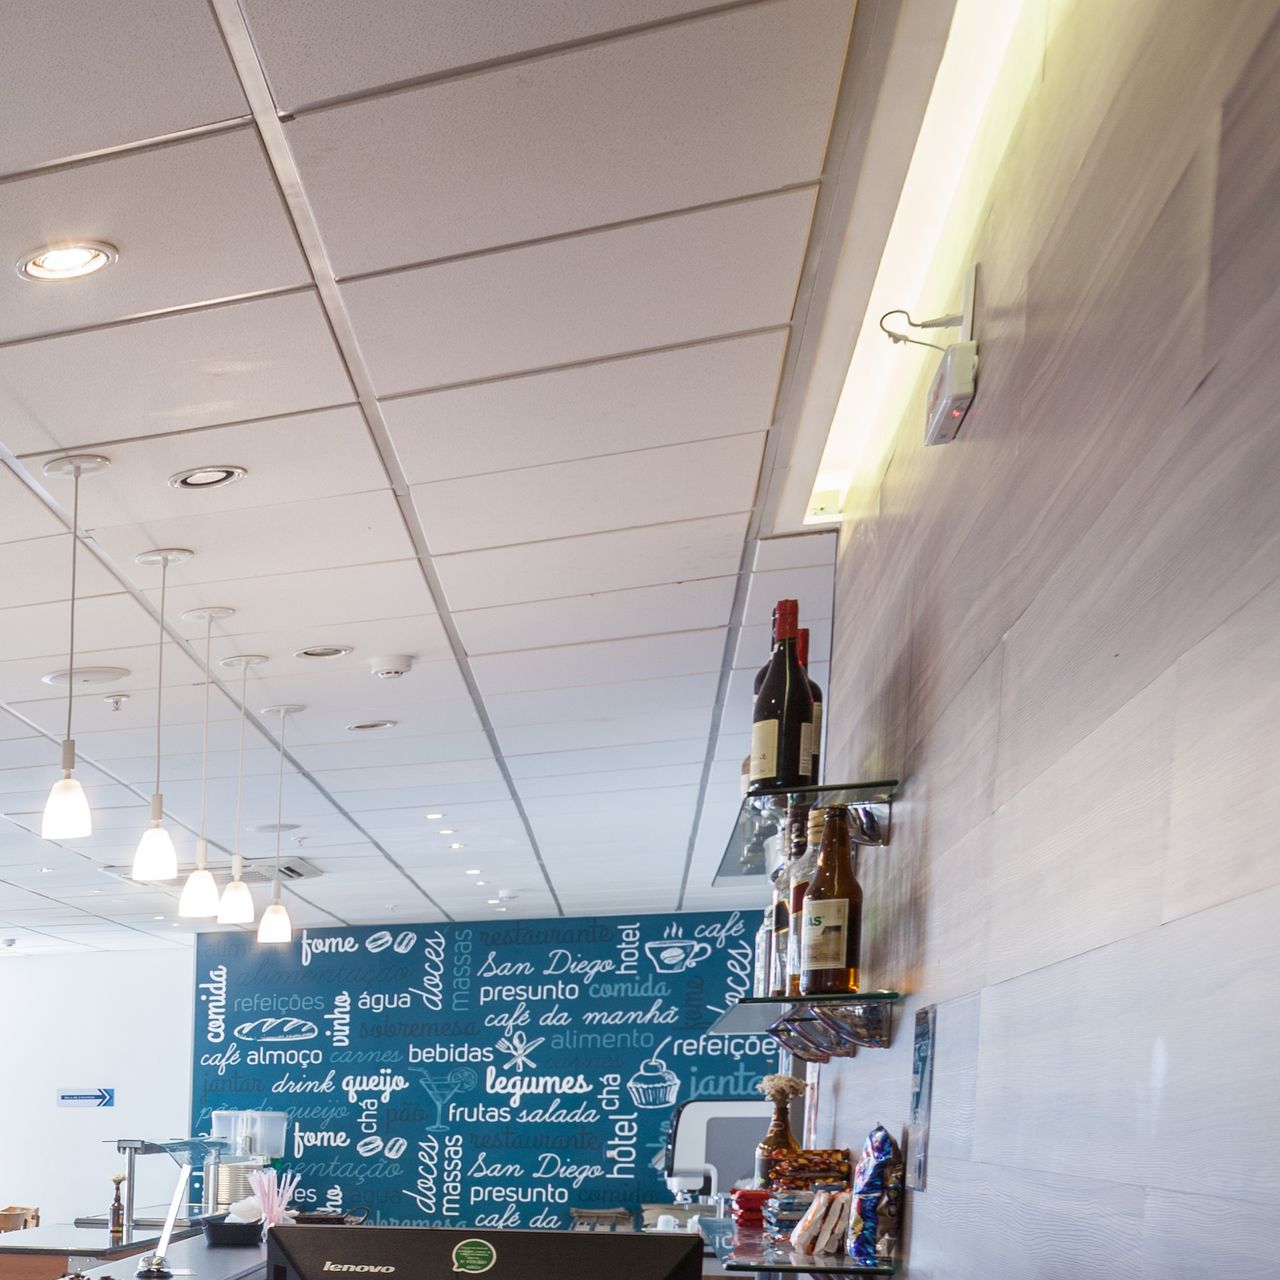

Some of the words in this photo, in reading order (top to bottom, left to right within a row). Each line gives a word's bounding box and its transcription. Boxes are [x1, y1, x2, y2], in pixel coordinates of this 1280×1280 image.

[479, 917, 614, 946] restaurante
[694, 911, 745, 948] café
[301, 929, 359, 966] fome
[615, 922, 641, 975] hotel
[408, 930, 446, 1011] doces
[452, 928, 473, 1012] massas
[477, 951, 535, 977] San
[542, 950, 615, 984] Diego
[358, 992, 412, 1012] água
[480, 980, 579, 1005] presunto
[589, 974, 671, 998] comida
[199, 965, 228, 1044] comida
[234, 993, 325, 1017] refeições
[324, 991, 352, 1047] vinho
[484, 1002, 531, 1036] café
[539, 1005, 571, 1026] da
[583, 999, 679, 1025] manhã
[359, 1014, 480, 1038] sobremesa
[551, 1029, 654, 1049] alimento
[200, 1042, 241, 1075] café
[246, 1048, 323, 1068] almoço
[330, 1048, 403, 1064] carnes
[409, 1044, 494, 1063] bebidas
[673, 1036, 781, 1059] refeiçõe
[200, 1072, 266, 1105] jantar
[271, 1070, 336, 1094] drink
[341, 1067, 409, 1104] queijo
[485, 1066, 593, 1108] legumes
[597, 1073, 622, 1110] chá
[689, 1061, 758, 1098] janta
[285, 1098, 350, 1129] queijo
[357, 1099, 378, 1134] chá
[448, 1102, 511, 1123] frutas
[516, 1098, 600, 1124] salada
[293, 1121, 351, 1158] fome
[469, 1126, 603, 1150] restaurante
[606, 1112, 638, 1179] hotel
[402, 1134, 440, 1214] doces
[441, 1134, 463, 1217] massas
[467, 1152, 525, 1180] San
[532, 1153, 605, 1189] Diego
[470, 1184, 569, 1205] presunto
[475, 1204, 521, 1229] café
[530, 1207, 562, 1228] da
[323, 1261, 395, 1273] lenovo
